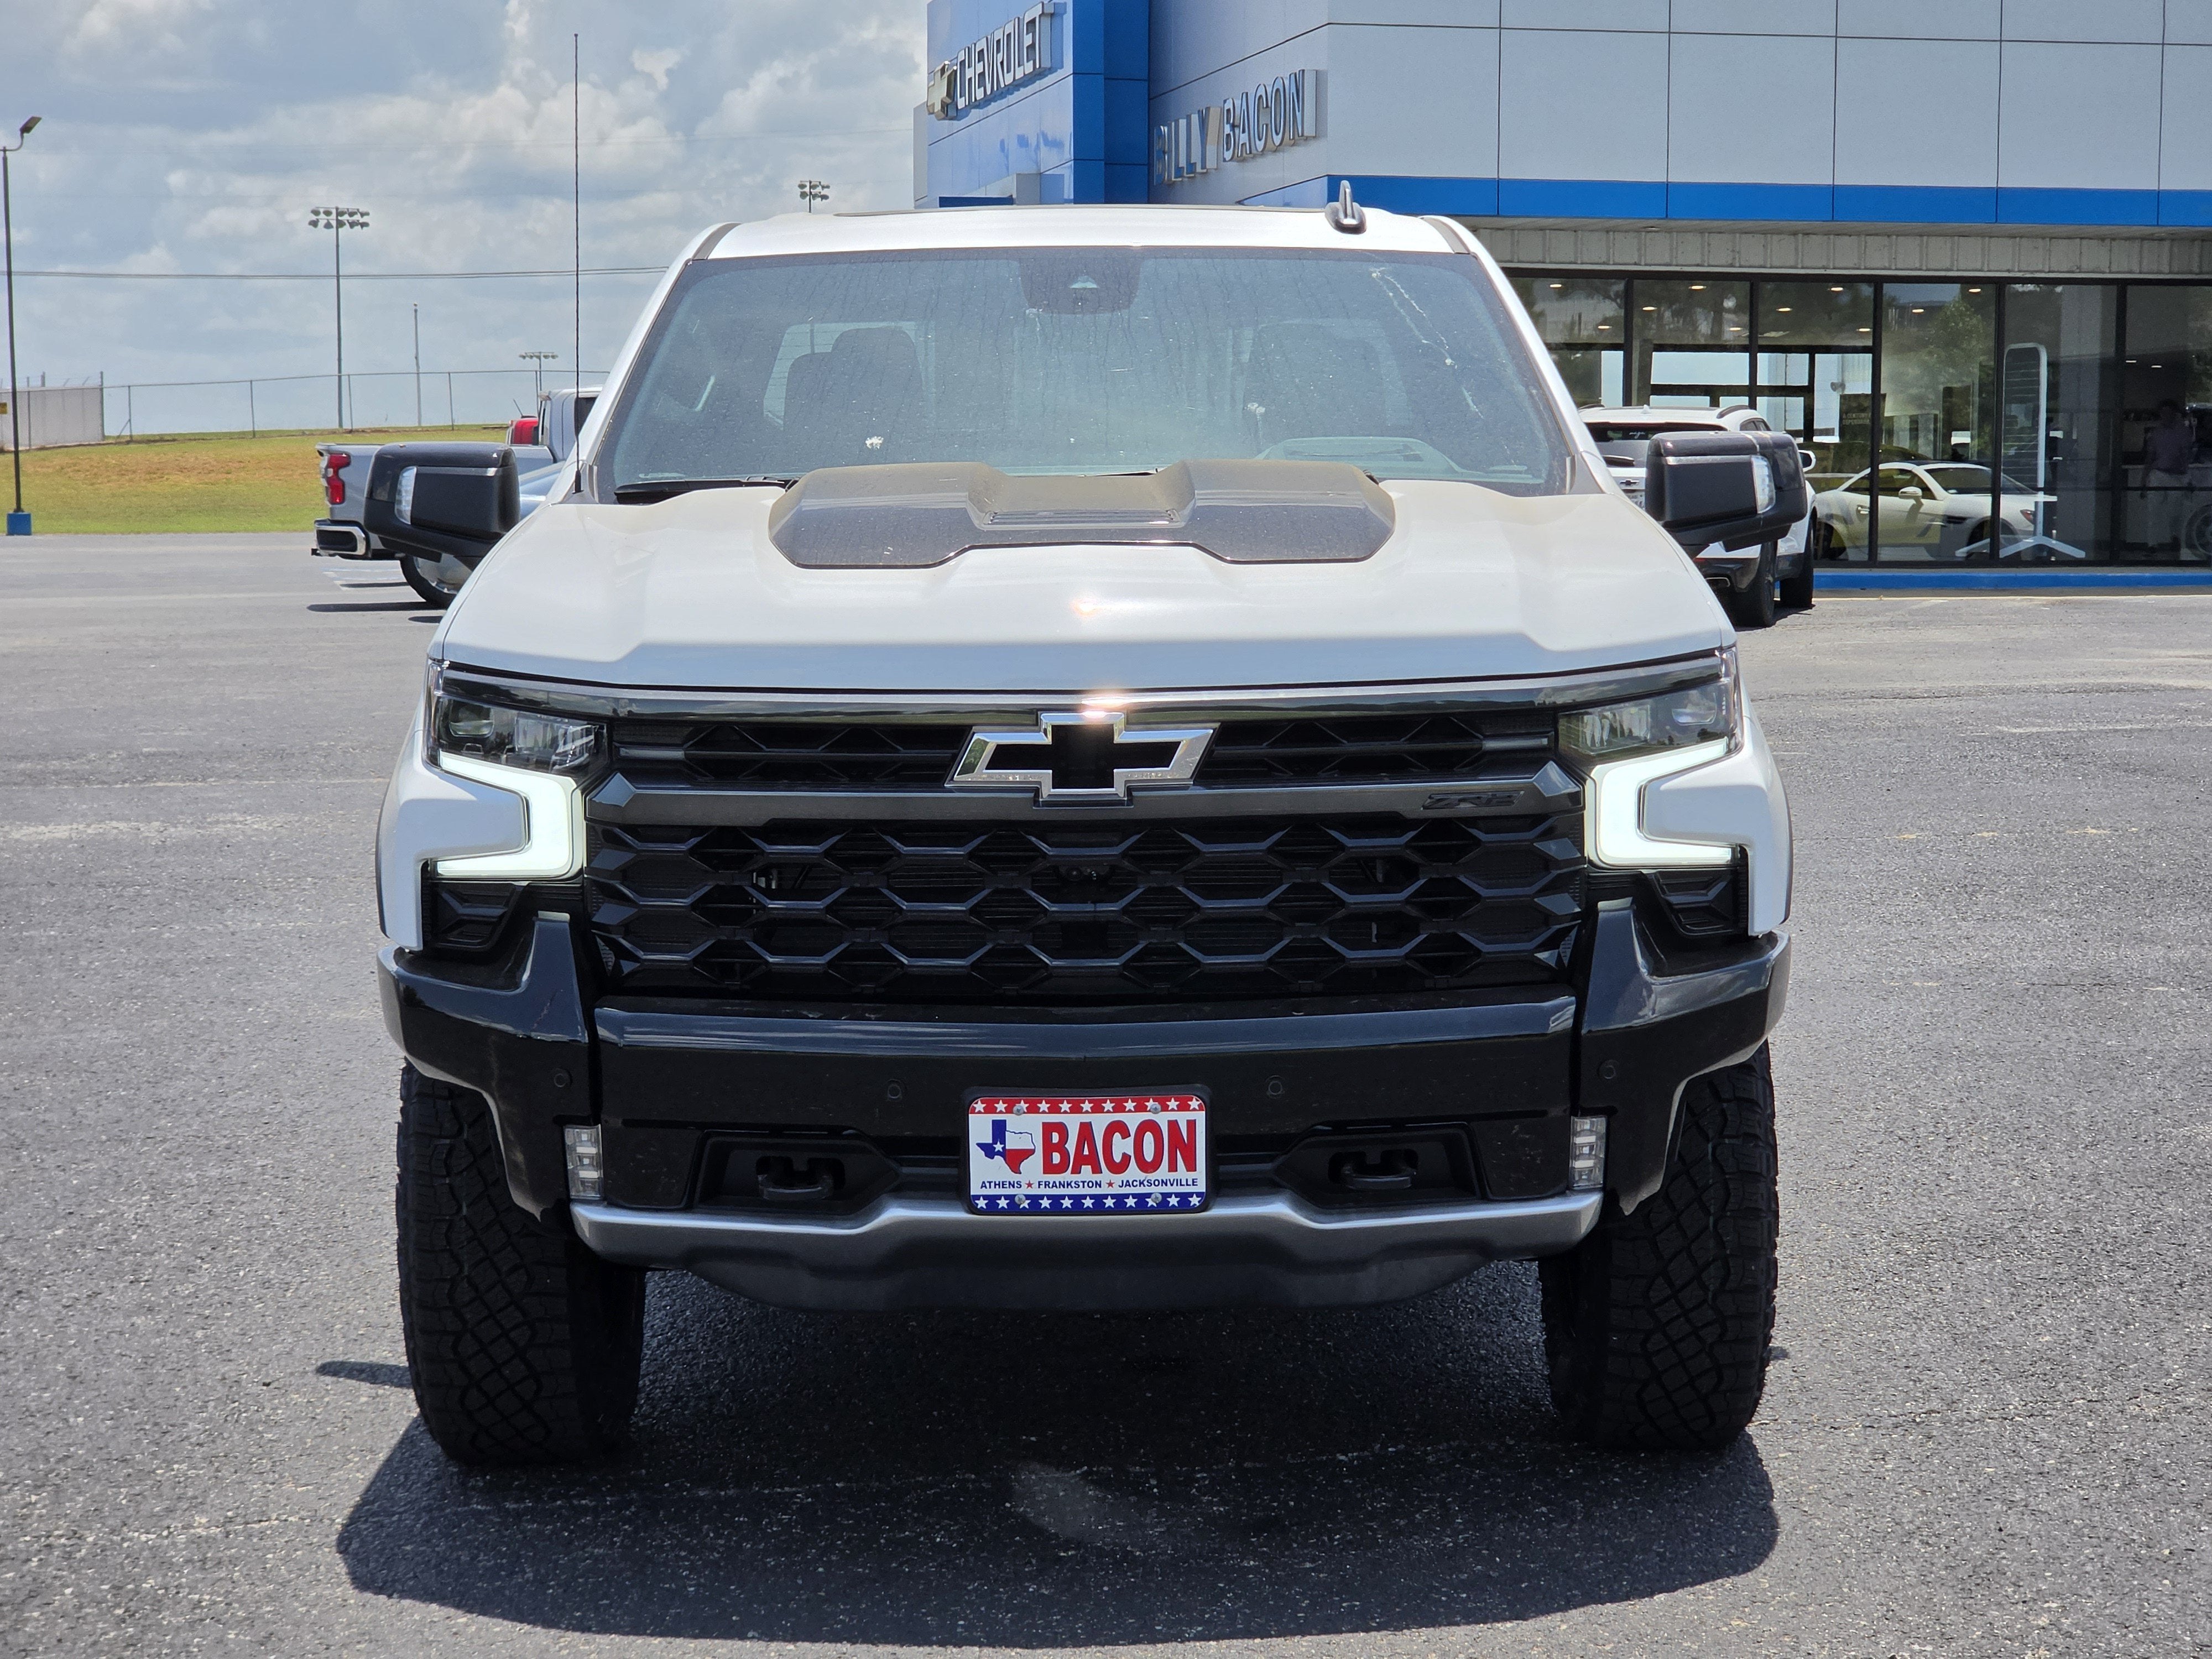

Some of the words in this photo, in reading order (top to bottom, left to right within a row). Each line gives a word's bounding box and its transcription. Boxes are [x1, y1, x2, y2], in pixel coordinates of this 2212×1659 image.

[956, 2, 1051, 109] CHEVROLET
[1154, 106, 1220, 185] BILLY
[1223, 69, 1317, 162] BACON
[980, 1180, 1022, 1190] ATHENS
[1037, 1180, 1102, 1189] FRANKSTON
[1118, 1178, 1198, 1187] JACKSONVILLE
[1041, 1119, 1197, 1175] BACON
